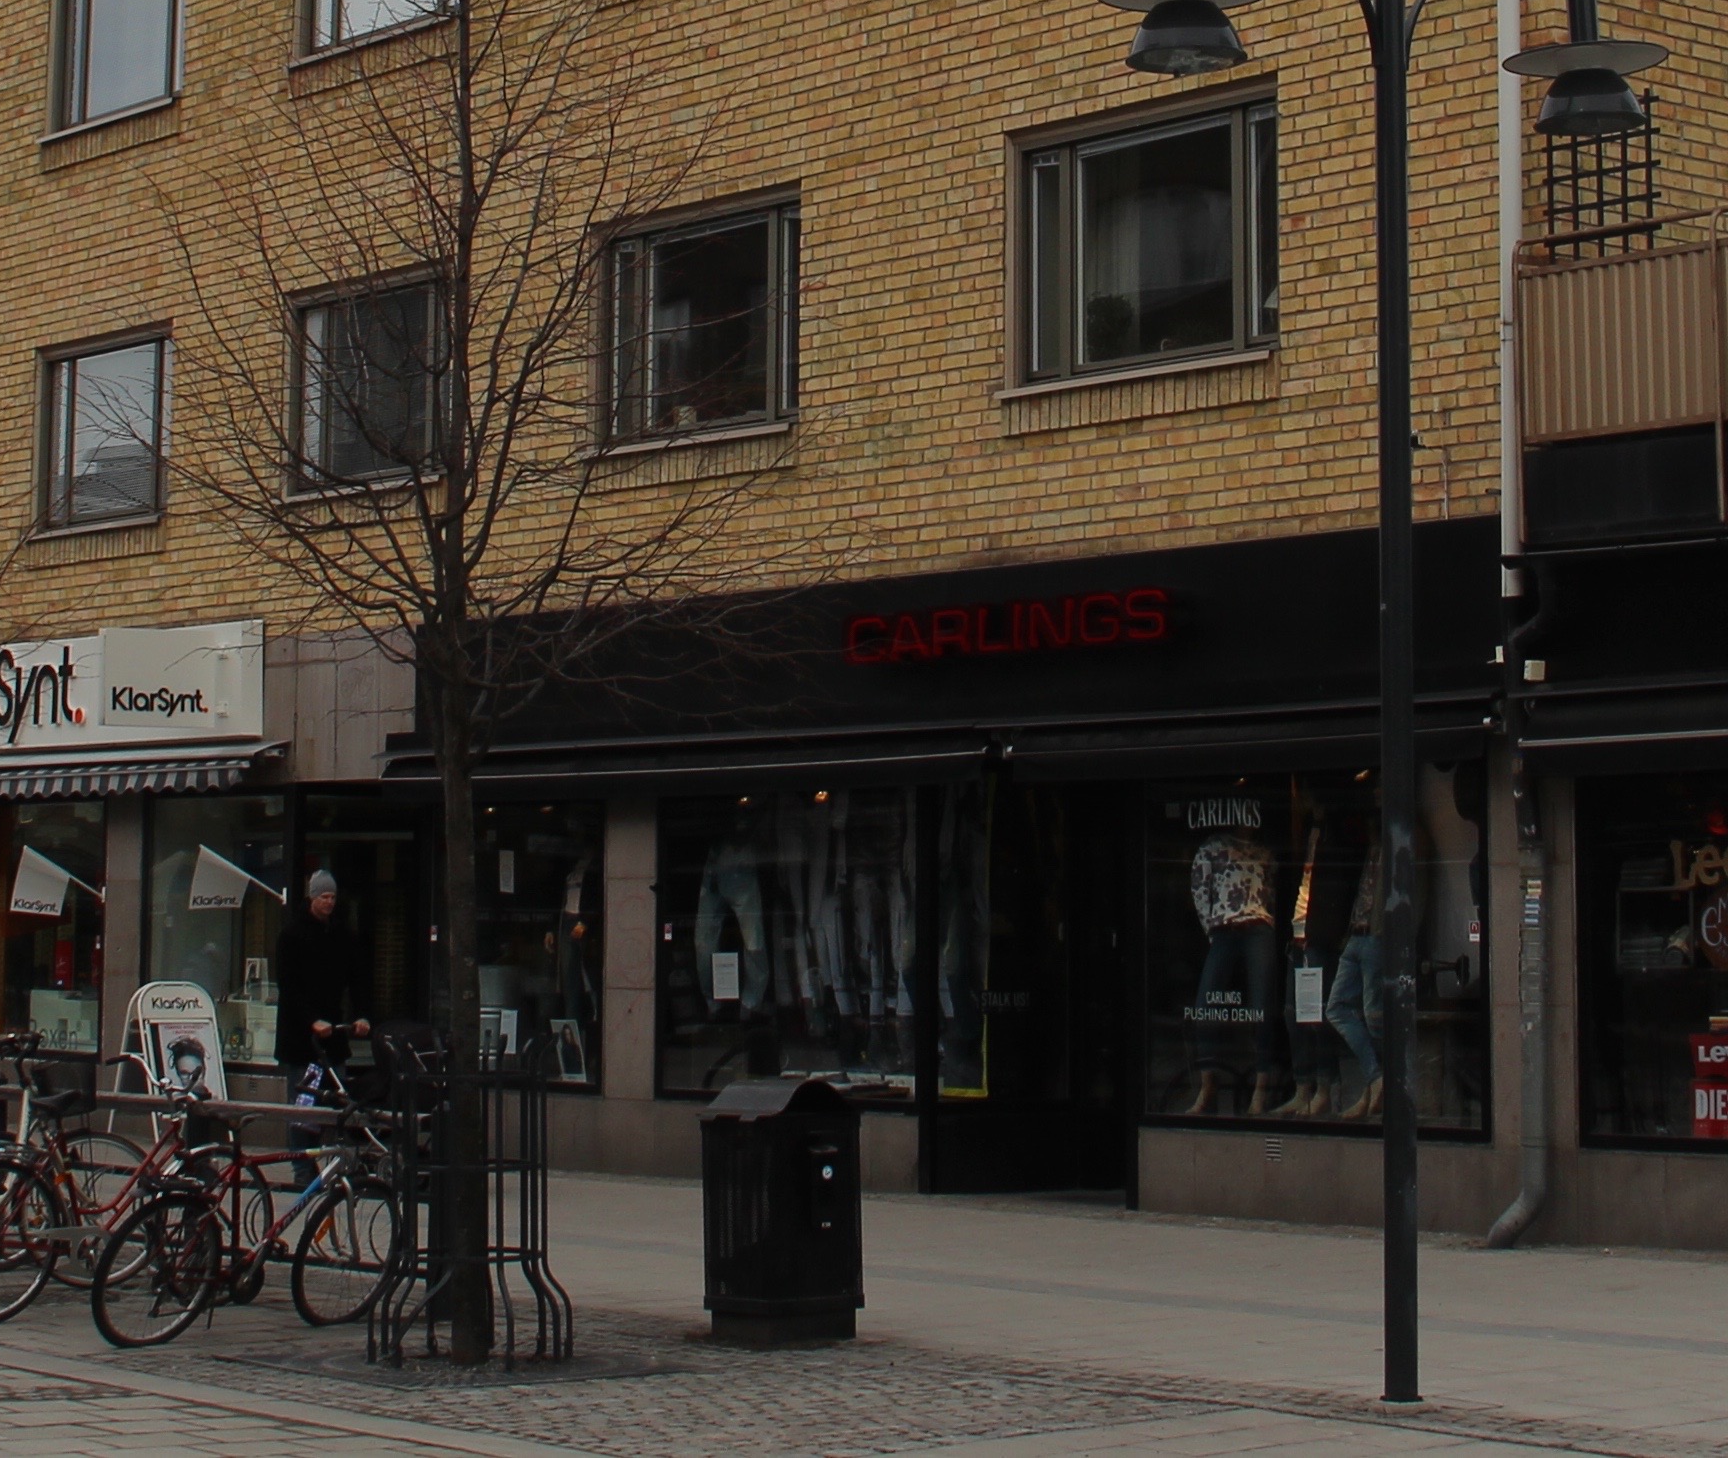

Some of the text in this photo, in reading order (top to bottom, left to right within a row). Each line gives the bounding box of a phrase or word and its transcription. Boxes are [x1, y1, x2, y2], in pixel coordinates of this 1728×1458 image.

[846, 585, 1169, 663] CARLINGS
[1187, 797, 1262, 830] CARLINGS
[1206, 990, 1242, 1005] CARLINGS
[1183, 1006, 1265, 1022] PUSHING DENIM
